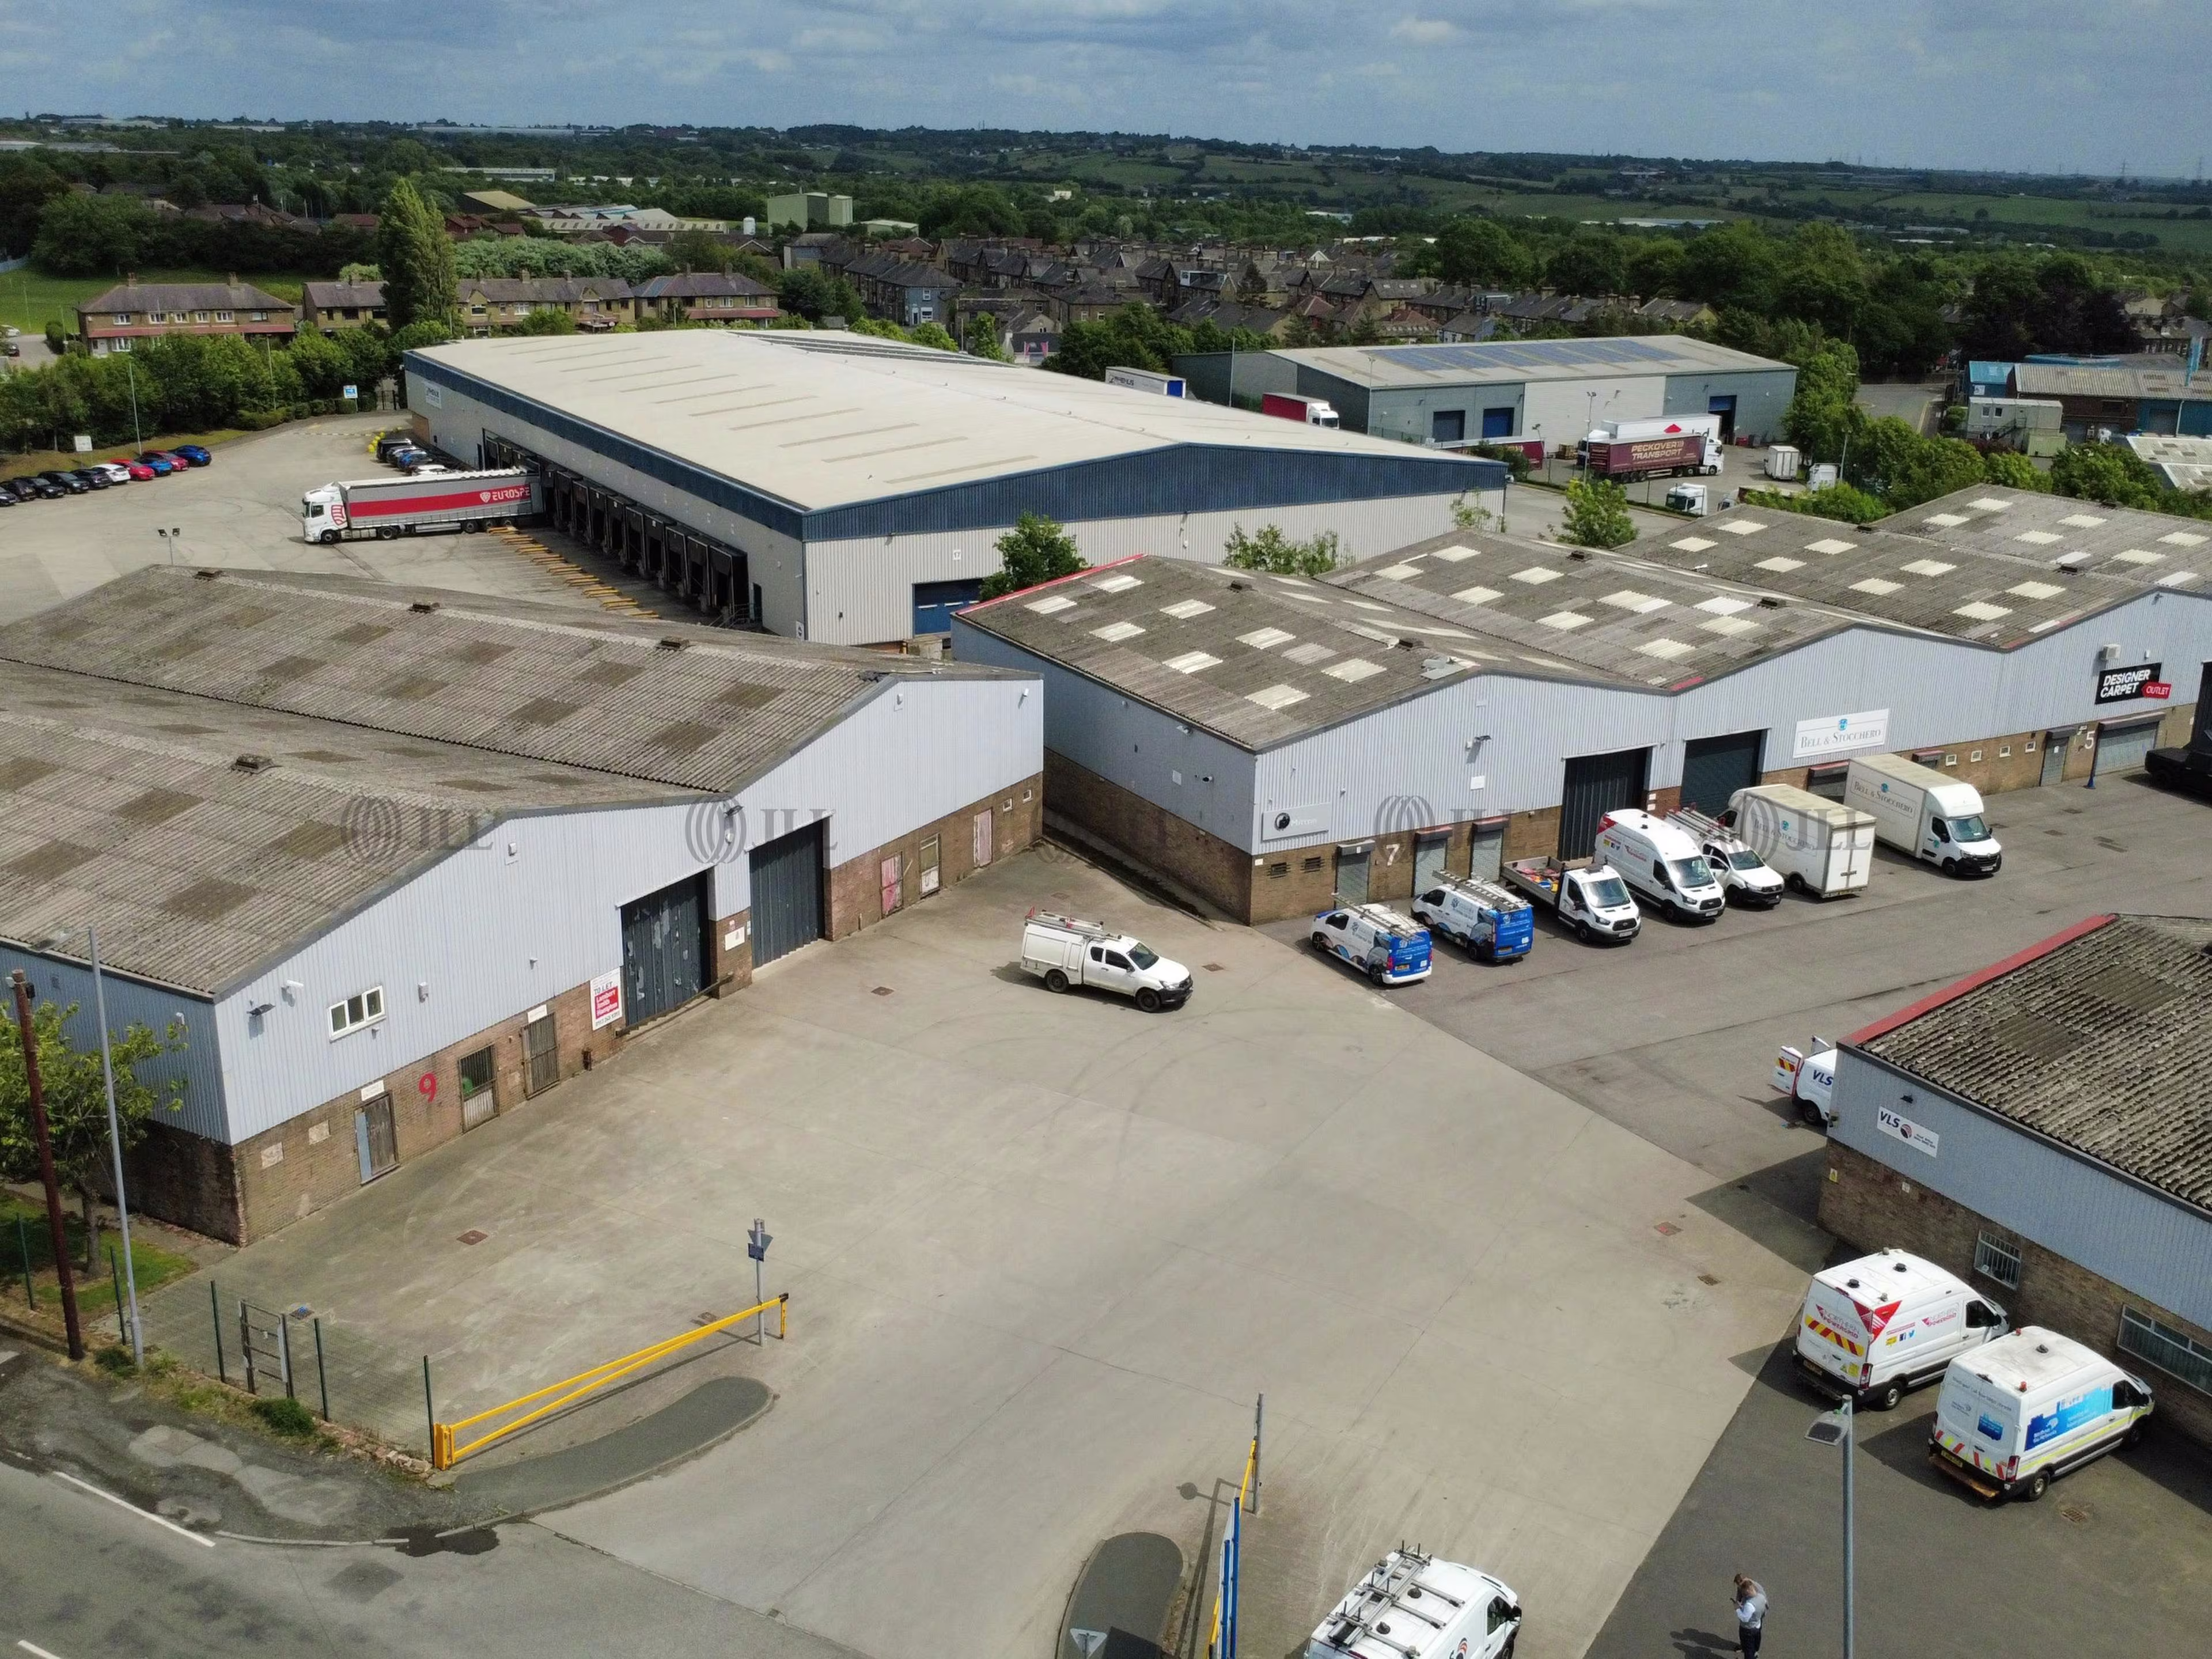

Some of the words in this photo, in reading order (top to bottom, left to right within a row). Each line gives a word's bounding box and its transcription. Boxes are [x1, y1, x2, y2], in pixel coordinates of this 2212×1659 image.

[1631, 441, 1677, 453] PECKOVER
[1633, 449, 1682, 460] TRANSPORT
[2103, 669, 2151, 687] DESIGNER
[2100, 682, 2139, 698] CARPET
[2146, 686, 2169, 695] OUTLET
[1801, 736, 1823, 748] BELL
[1823, 737, 1831, 745] &
[2085, 730, 2096, 749] 5
[1386, 843, 1400, 866] 7
[1813, 1070, 1834, 1086] VLS
[418, 1073, 437, 1103] 9
[1880, 1111, 1900, 1128] VLS
